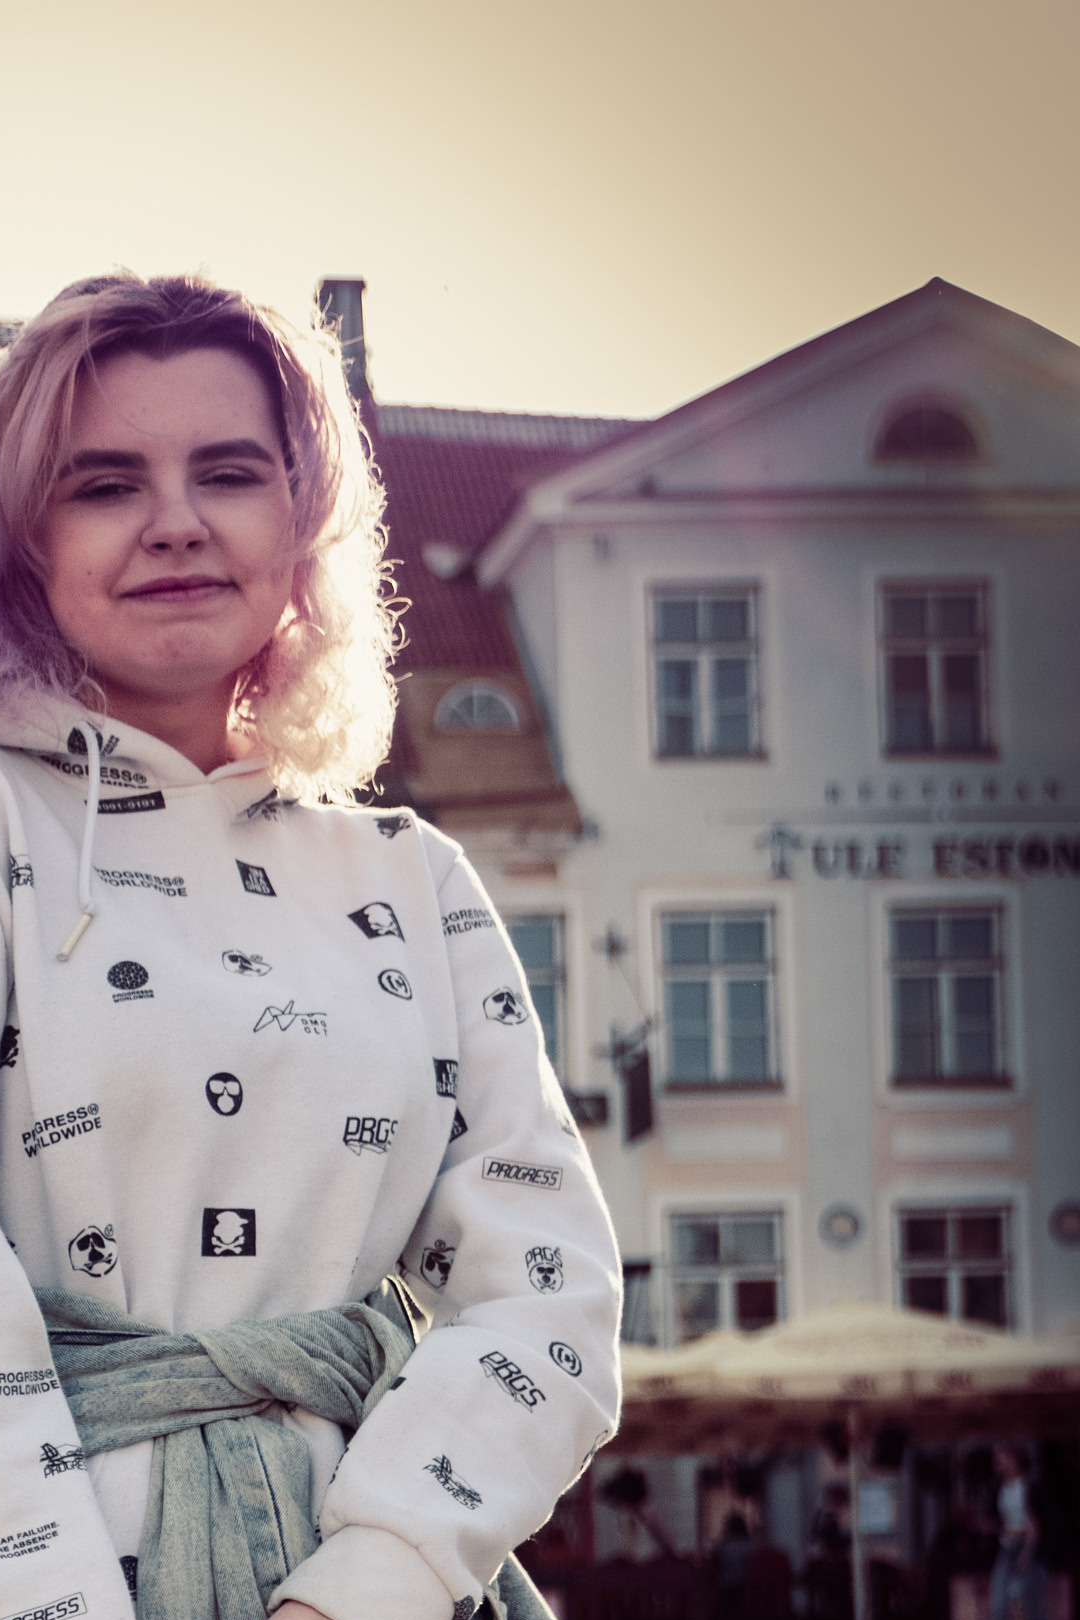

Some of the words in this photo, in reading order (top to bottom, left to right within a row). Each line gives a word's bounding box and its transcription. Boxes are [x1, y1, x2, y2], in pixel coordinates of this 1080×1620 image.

[487, 1161, 560, 1187] PROGRESS
[525, 1246, 563, 1269] PRGS
[479, 1350, 547, 1407] PRGS
[12, 1530, 59, 1551] ABSENCE
